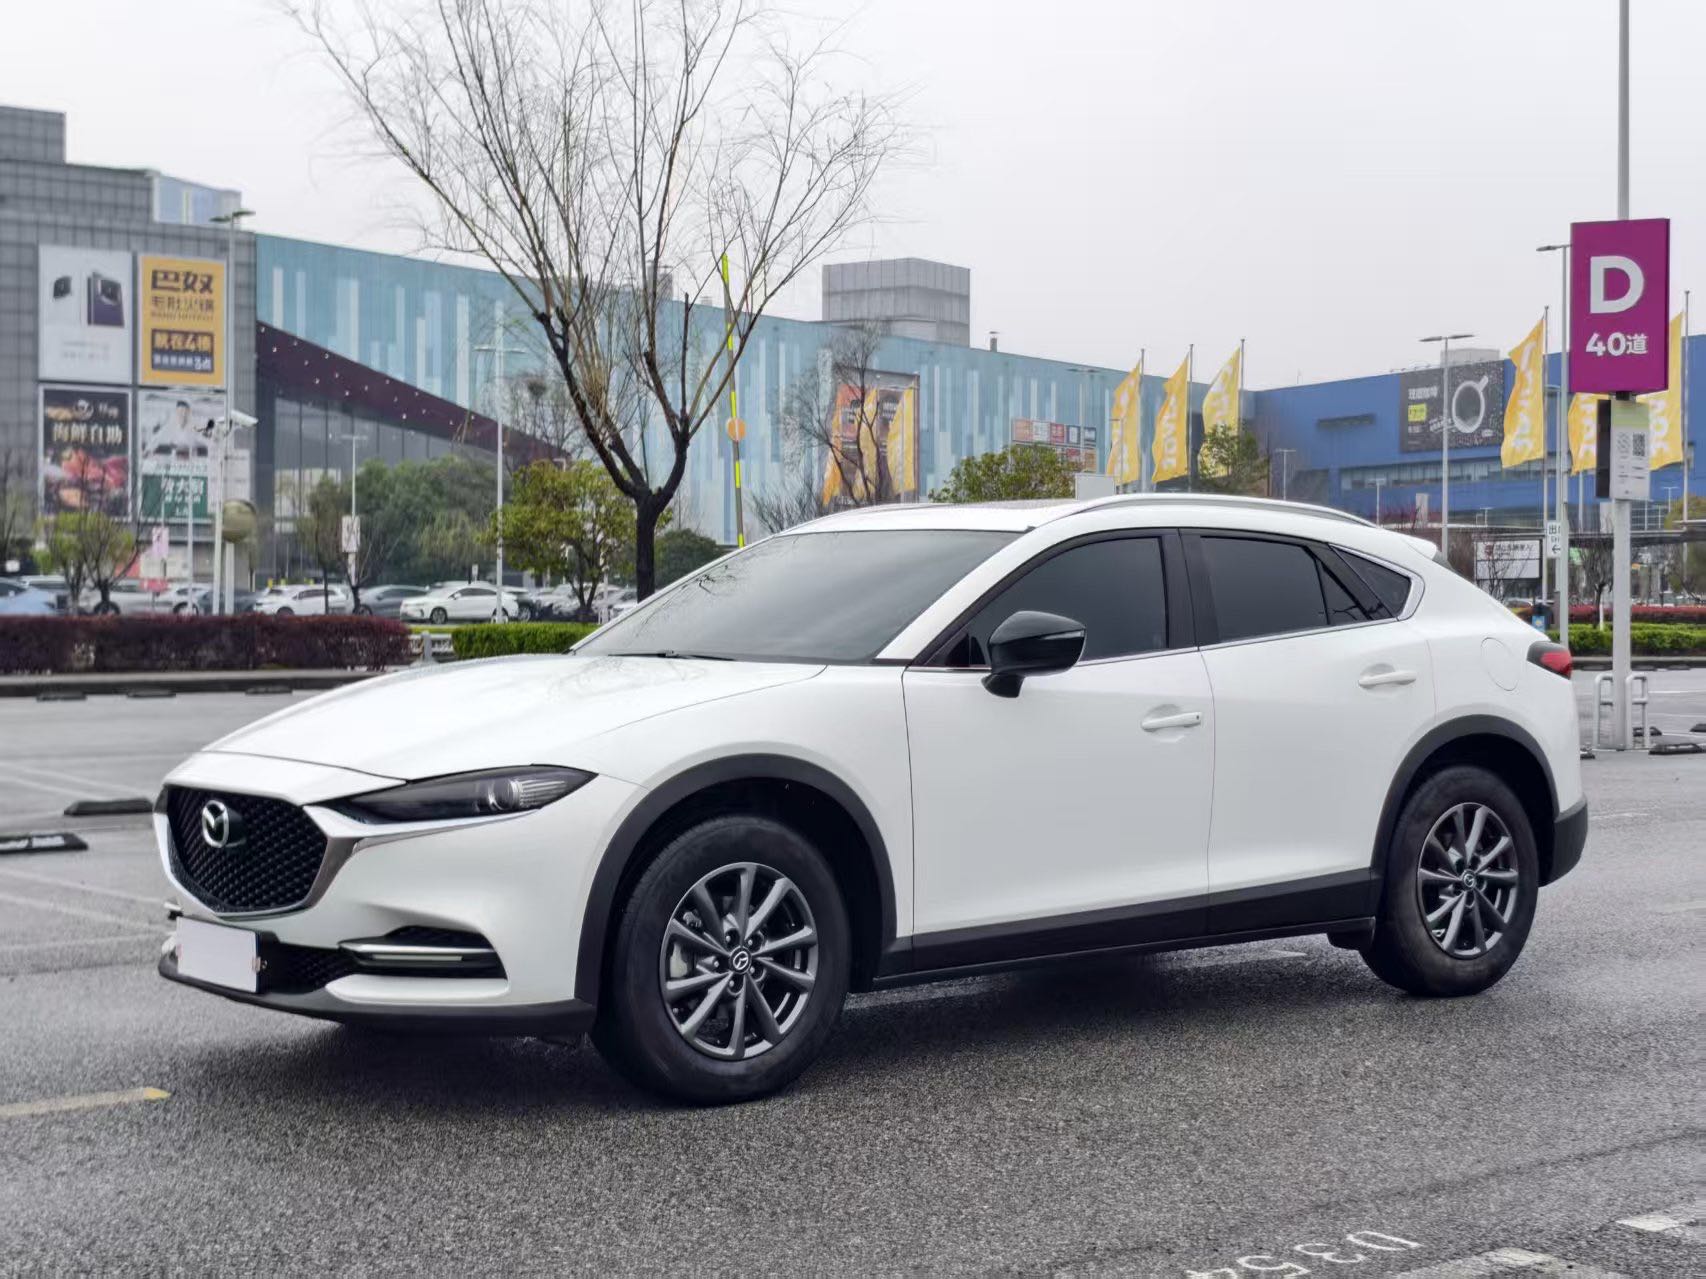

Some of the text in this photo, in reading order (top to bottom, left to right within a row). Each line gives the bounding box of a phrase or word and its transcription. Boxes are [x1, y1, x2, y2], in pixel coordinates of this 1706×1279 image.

[152, 270, 213, 294] 巴奴
[1590, 255, 1645, 313] D
[1585, 332, 1649, 357] 40道
